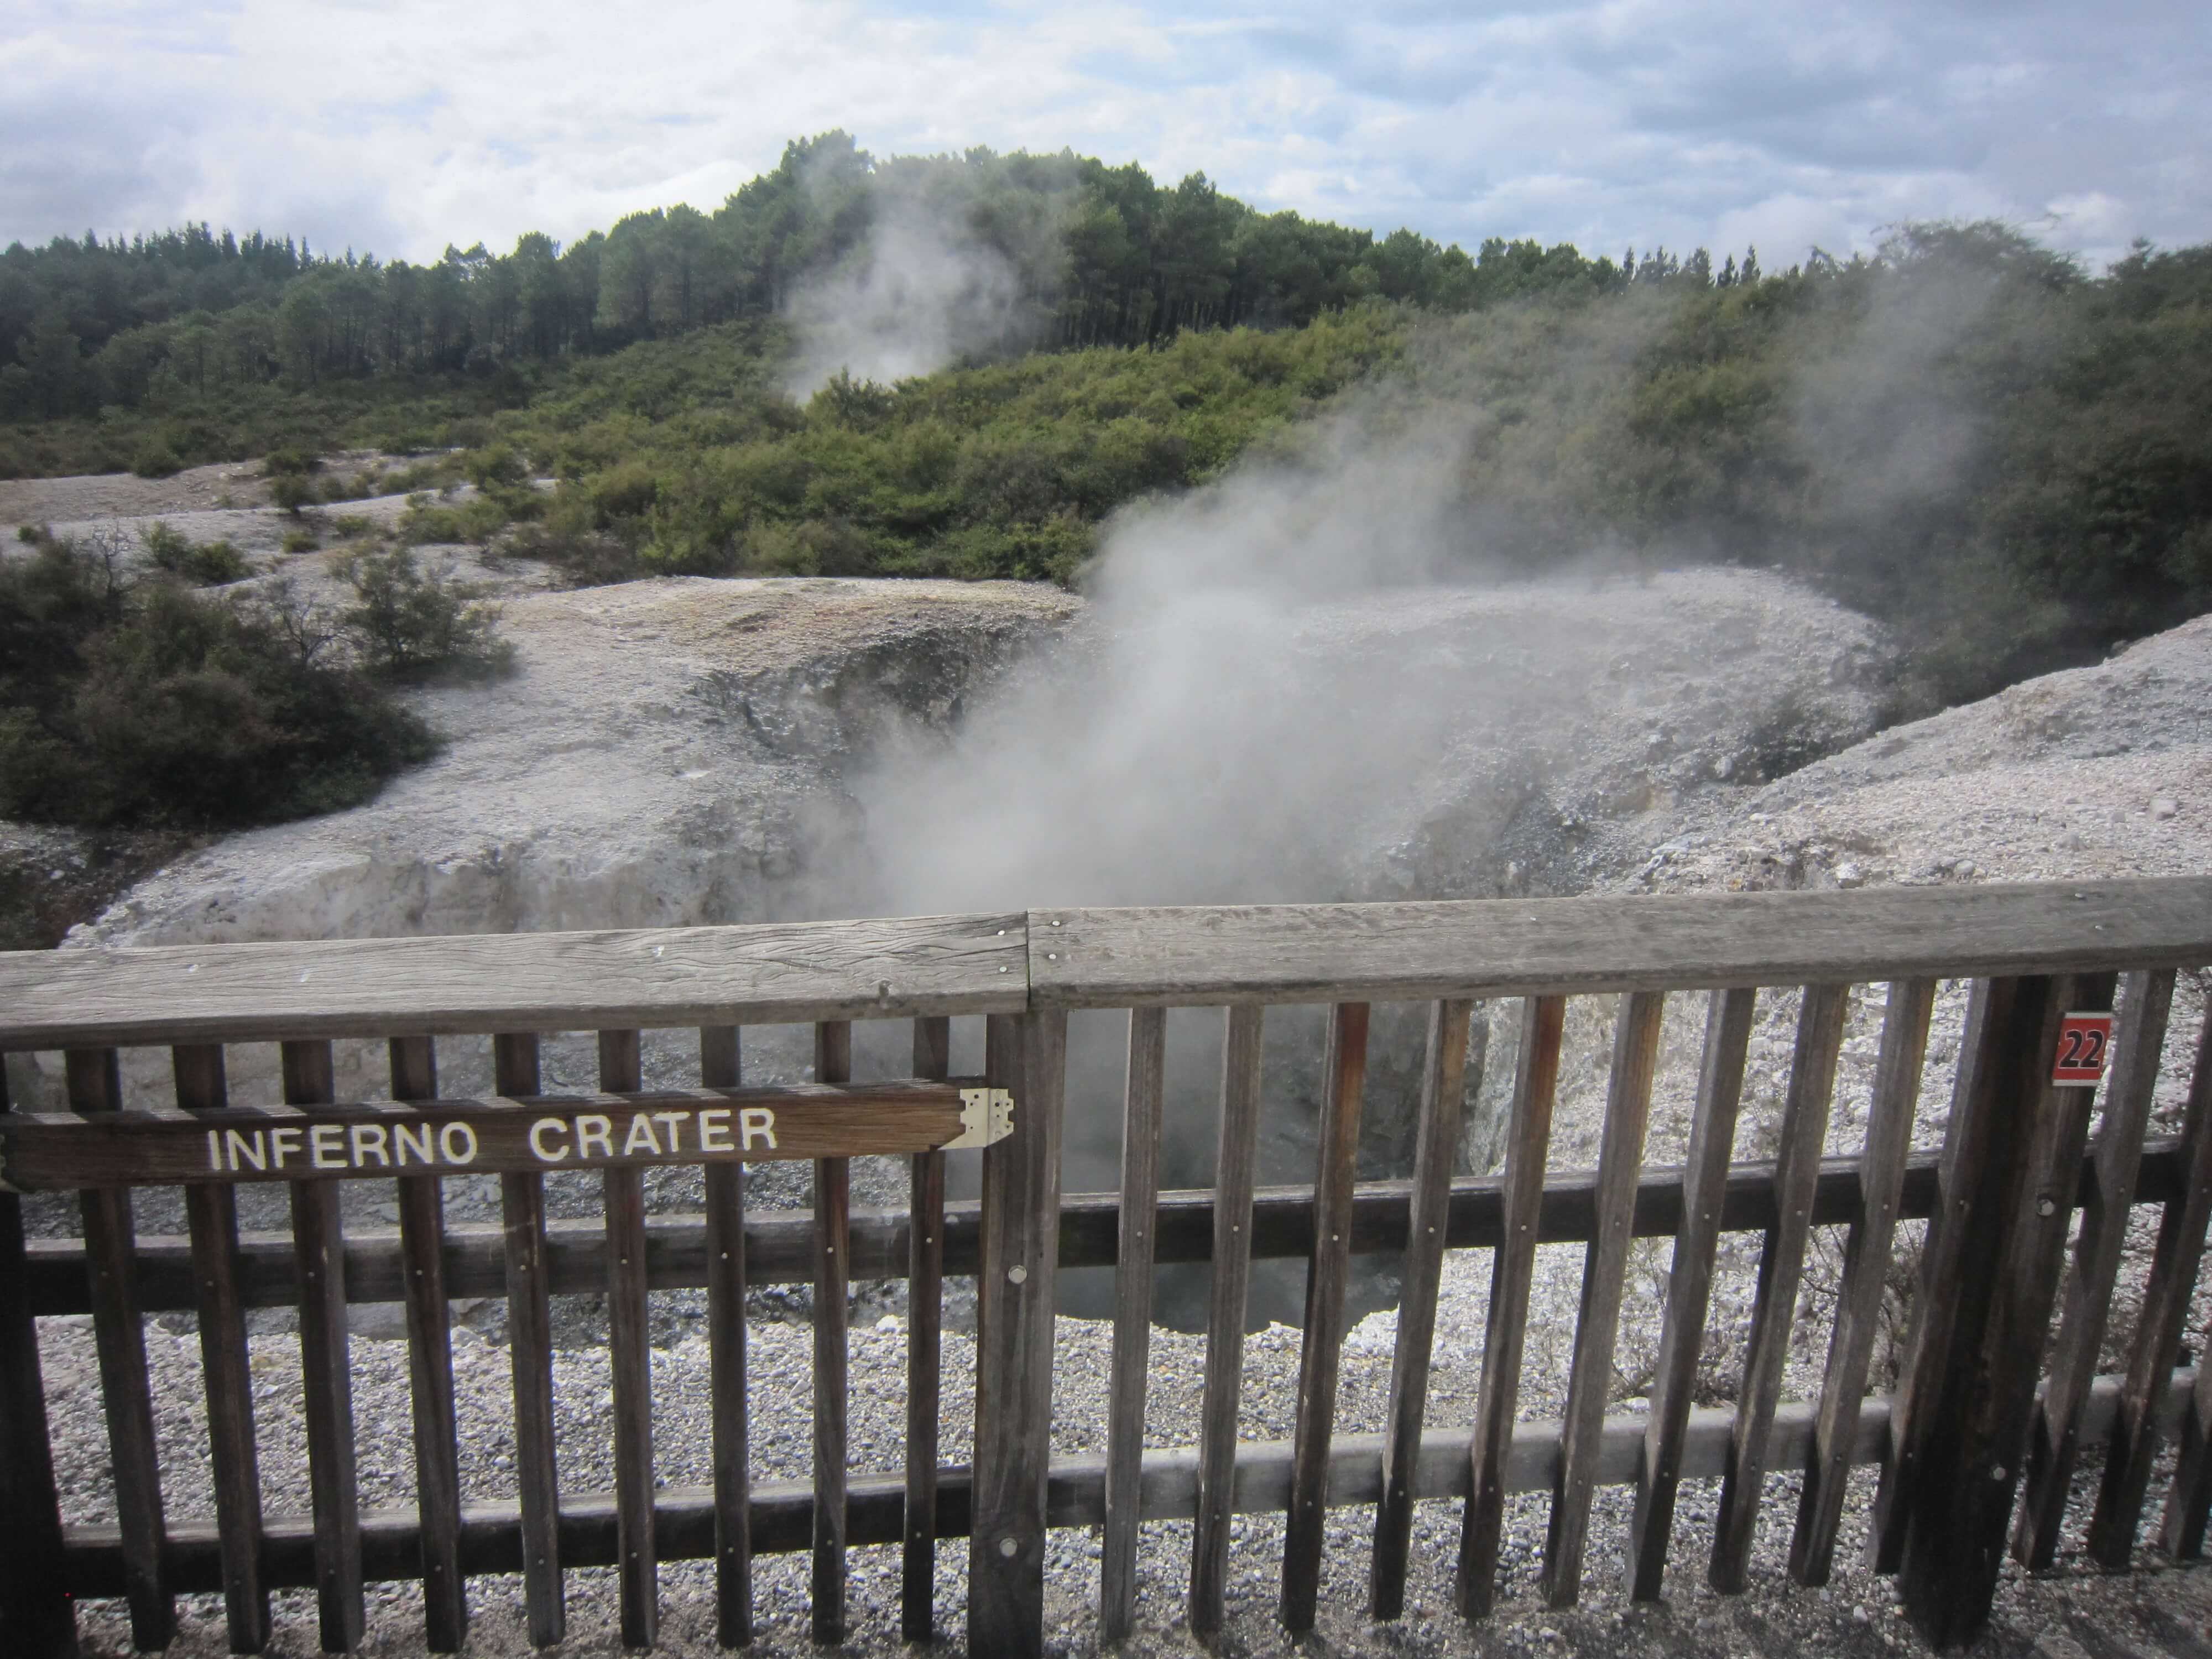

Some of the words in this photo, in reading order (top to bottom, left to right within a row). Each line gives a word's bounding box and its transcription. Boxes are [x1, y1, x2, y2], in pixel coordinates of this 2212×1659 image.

[2058, 1029, 2104, 1069] 22
[207, 1121, 478, 1171] INFERNO
[530, 1108, 778, 1162] CRATER
